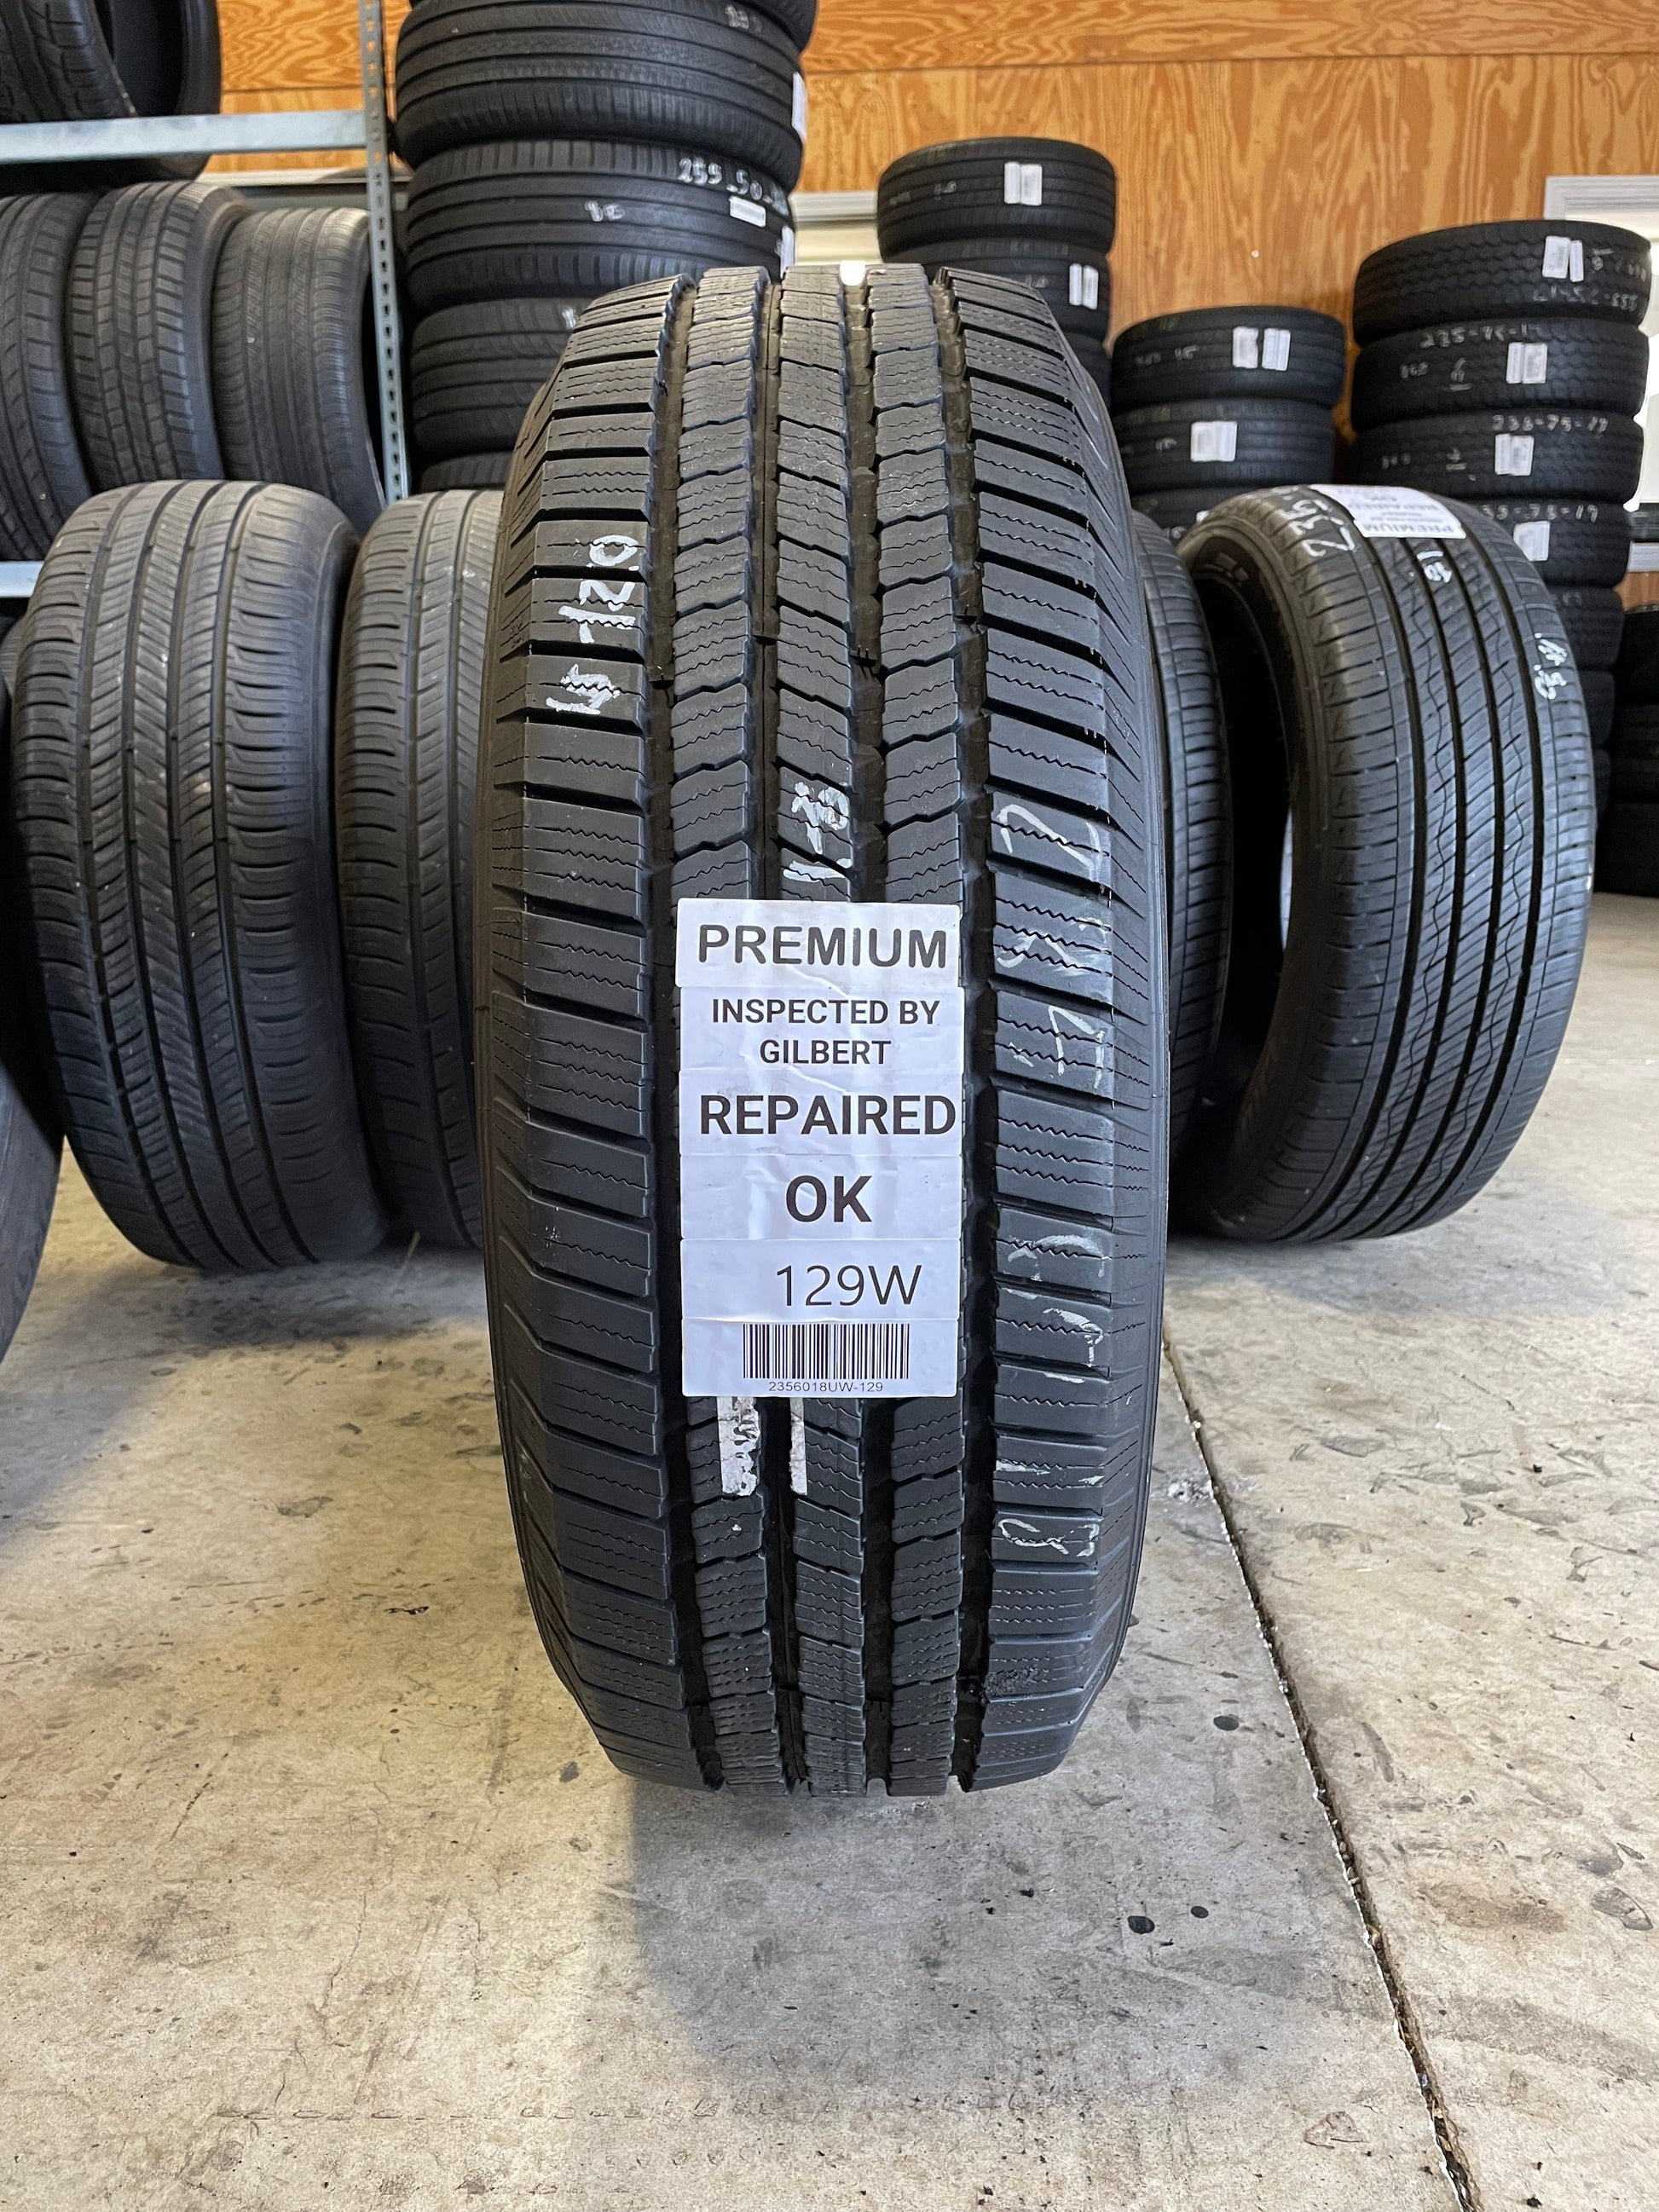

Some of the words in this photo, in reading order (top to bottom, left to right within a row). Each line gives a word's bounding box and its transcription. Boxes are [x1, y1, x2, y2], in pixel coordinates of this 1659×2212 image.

[698, 924, 946, 968] PREMIUM
[713, 999, 888, 1024] INSPECTED
[899, 1000, 941, 1025] BY
[760, 1040, 892, 1065] GILBERT
[701, 1095, 956, 1135] REPAIRED
[786, 1175, 872, 1222] OK
[777, 1265, 922, 1307] 129W
[768, 1381, 884, 1393] 2356018UW-129
